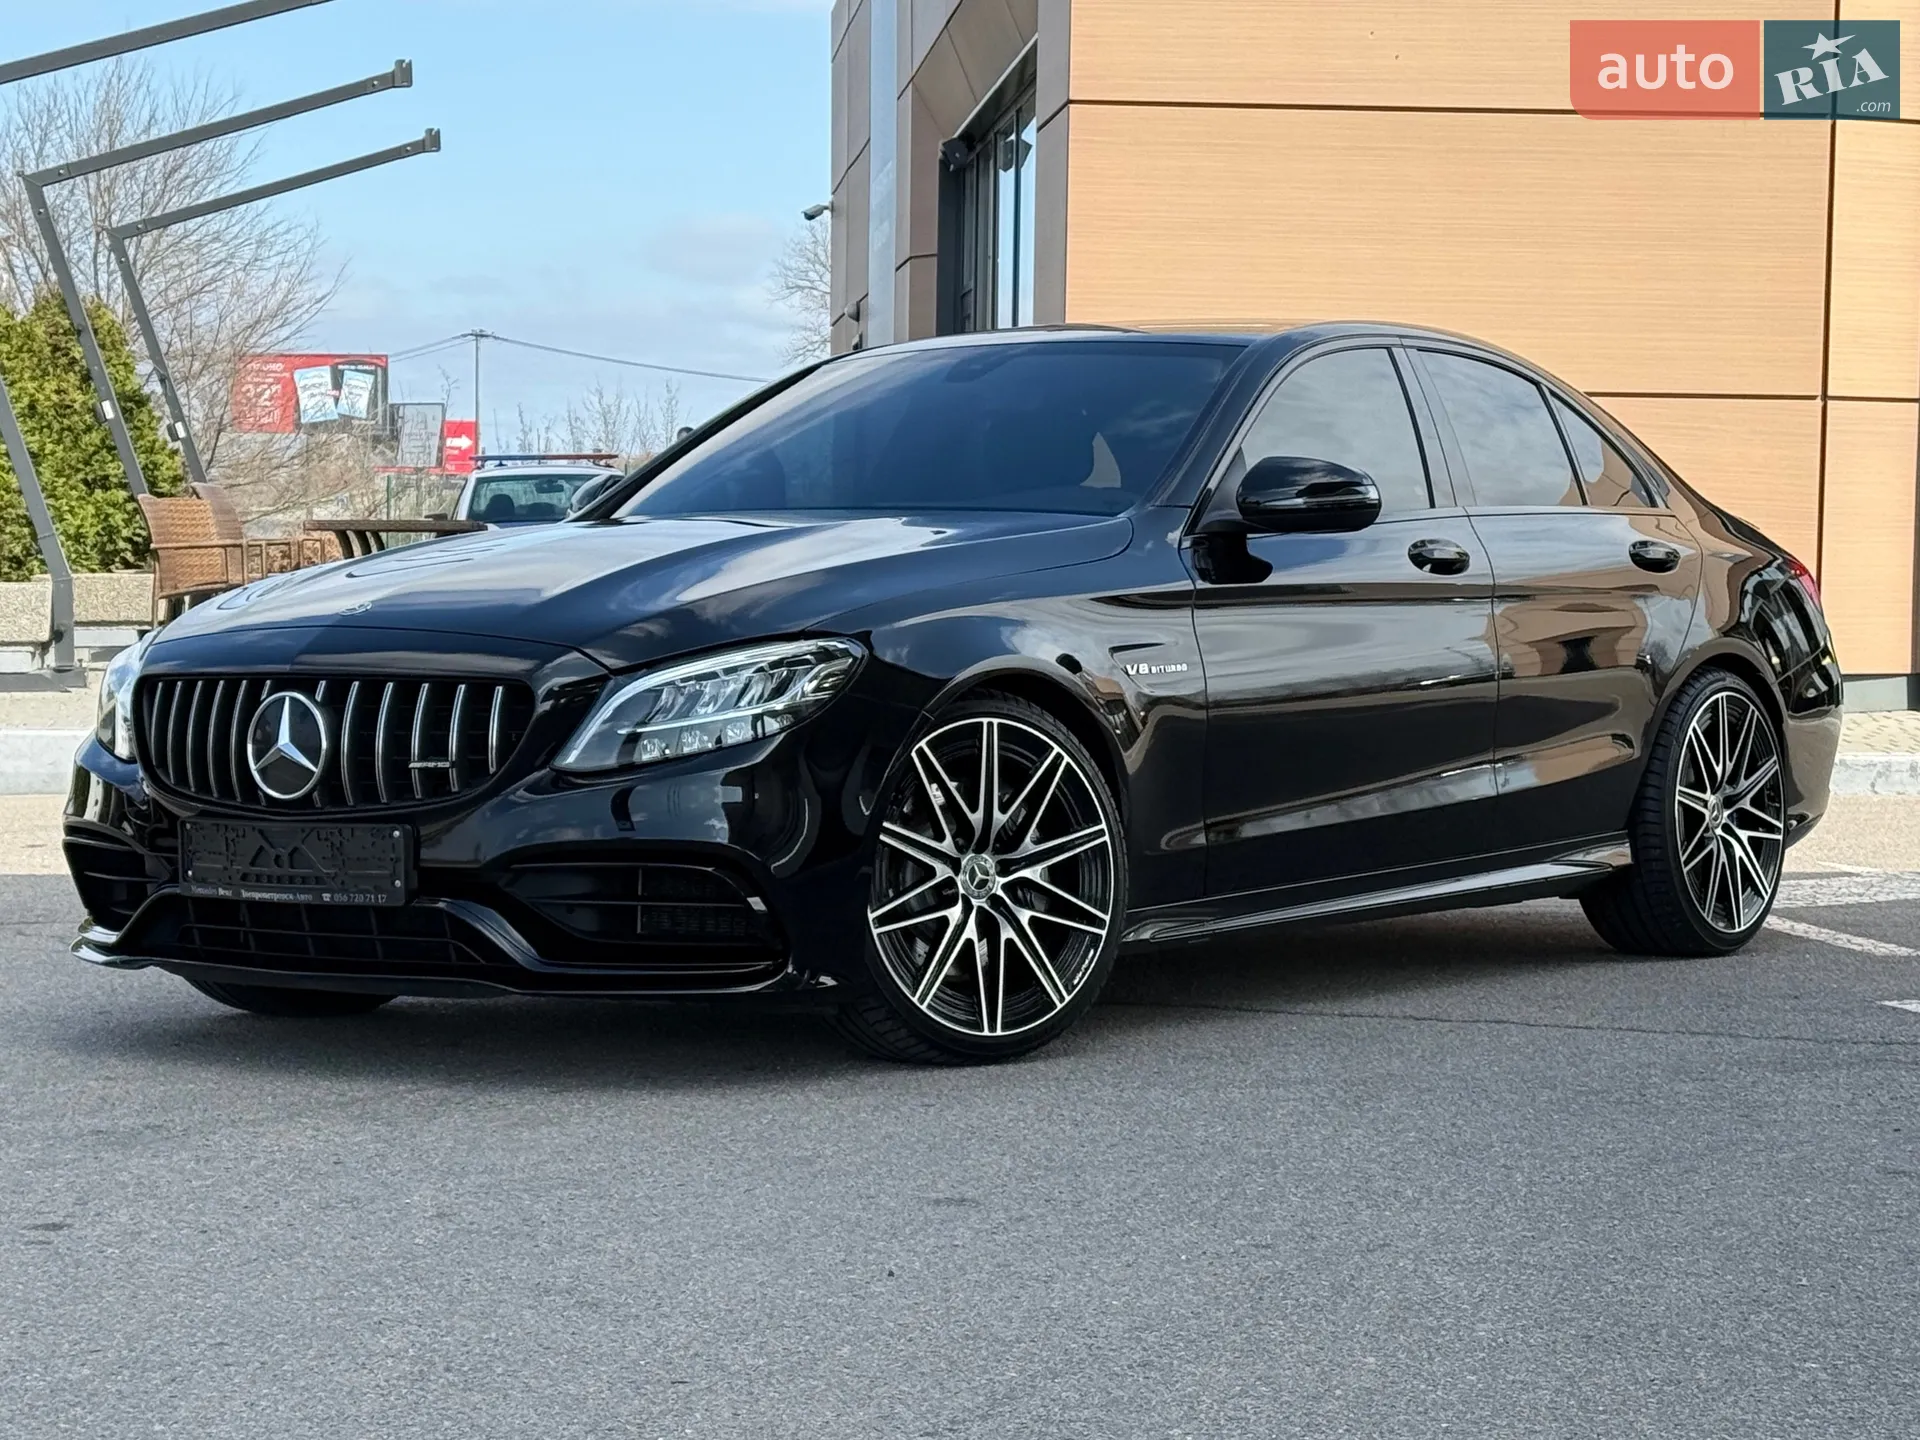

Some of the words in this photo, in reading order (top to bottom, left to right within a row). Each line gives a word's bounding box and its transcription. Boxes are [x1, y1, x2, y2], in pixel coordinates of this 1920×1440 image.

[1125, 663, 1149, 675] V8
[1150, 663, 1188, 674] BITURBO
[333, 893, 348, 902] 056
[349, 893, 364, 903] 720
[365, 894, 375, 903] 71
